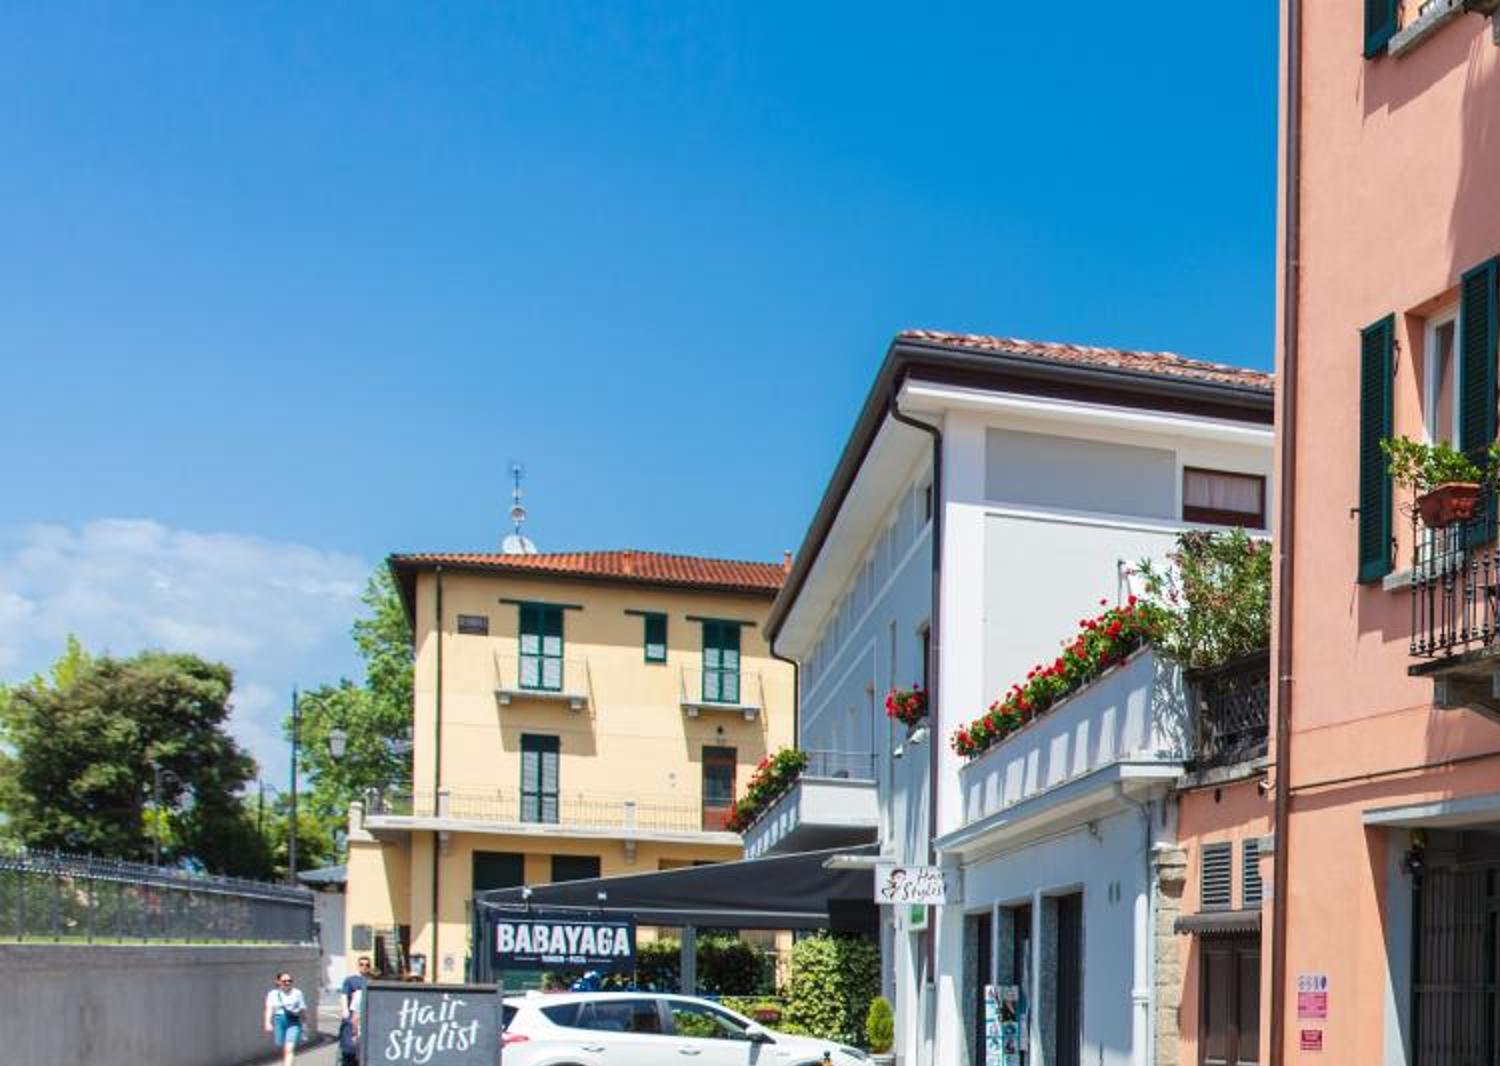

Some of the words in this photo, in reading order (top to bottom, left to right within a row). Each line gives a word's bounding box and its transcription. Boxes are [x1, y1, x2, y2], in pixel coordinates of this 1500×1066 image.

[496, 923, 631, 957] BABAYAGA
[398, 993, 468, 1029] Hair
[385, 1019, 480, 1064] Stylist
